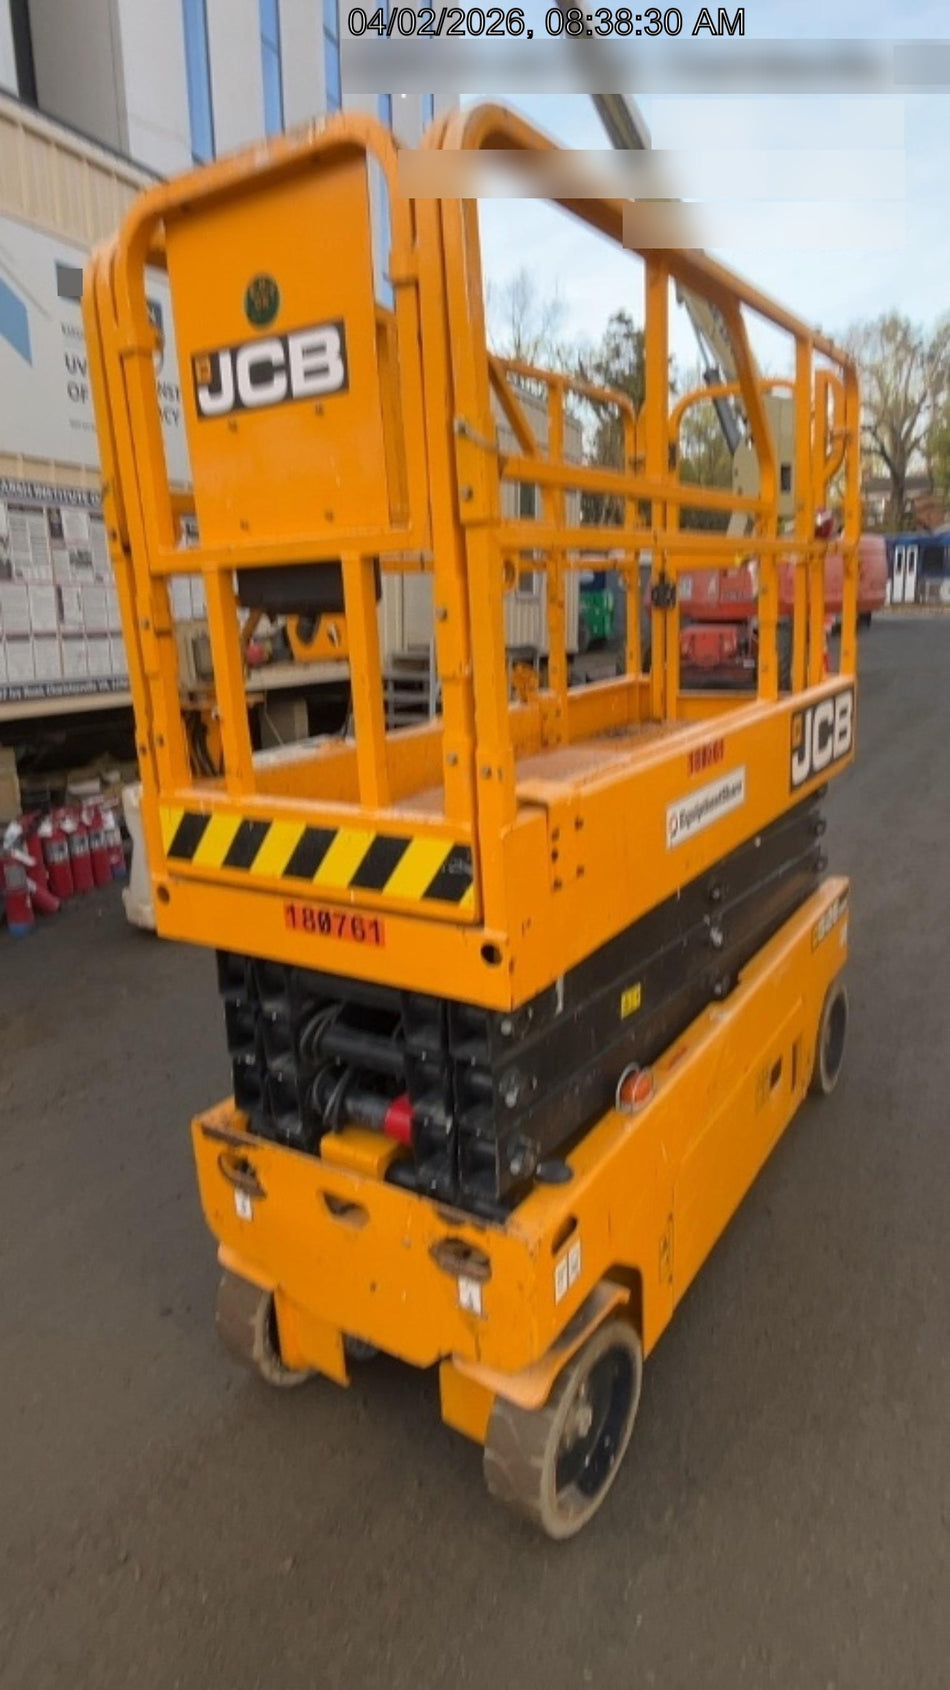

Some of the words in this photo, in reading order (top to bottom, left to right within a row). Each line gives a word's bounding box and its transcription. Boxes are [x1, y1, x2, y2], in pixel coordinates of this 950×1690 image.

[197, 324, 345, 416] JCB
[792, 690, 852, 786] JCB
[286, 903, 380, 946] 180761
